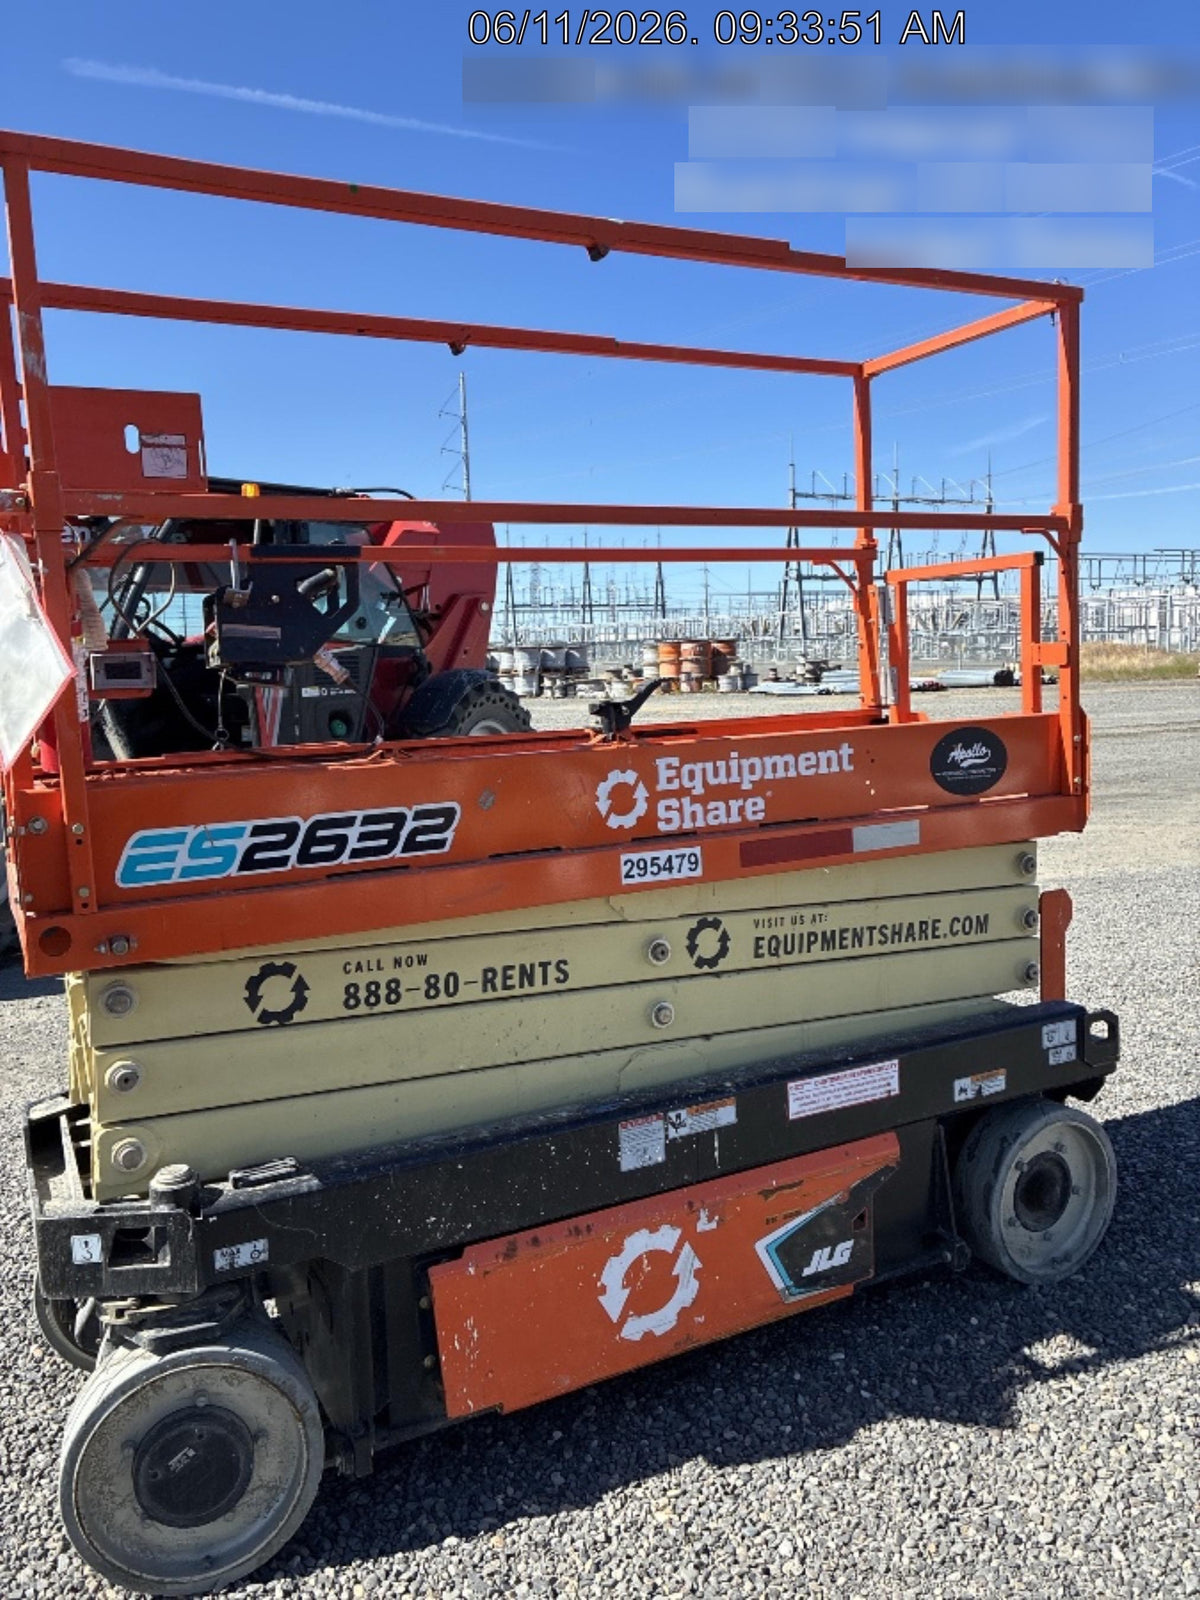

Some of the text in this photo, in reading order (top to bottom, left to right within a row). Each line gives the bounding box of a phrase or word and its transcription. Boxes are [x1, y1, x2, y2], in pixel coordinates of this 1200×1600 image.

[656, 743, 854, 796] Equipment
[657, 796, 766, 832] Share
[116, 802, 460, 887] ES2632
[622, 850, 700, 880] 295479
[753, 912, 828, 929] VISIT US AT:
[753, 913, 990, 959] EQUIPMENTSHARE.COM
[343, 953, 428, 975] CALL NOW
[342, 959, 570, 1011] 888-80-RENTS
[801, 1239, 854, 1277] JLG
